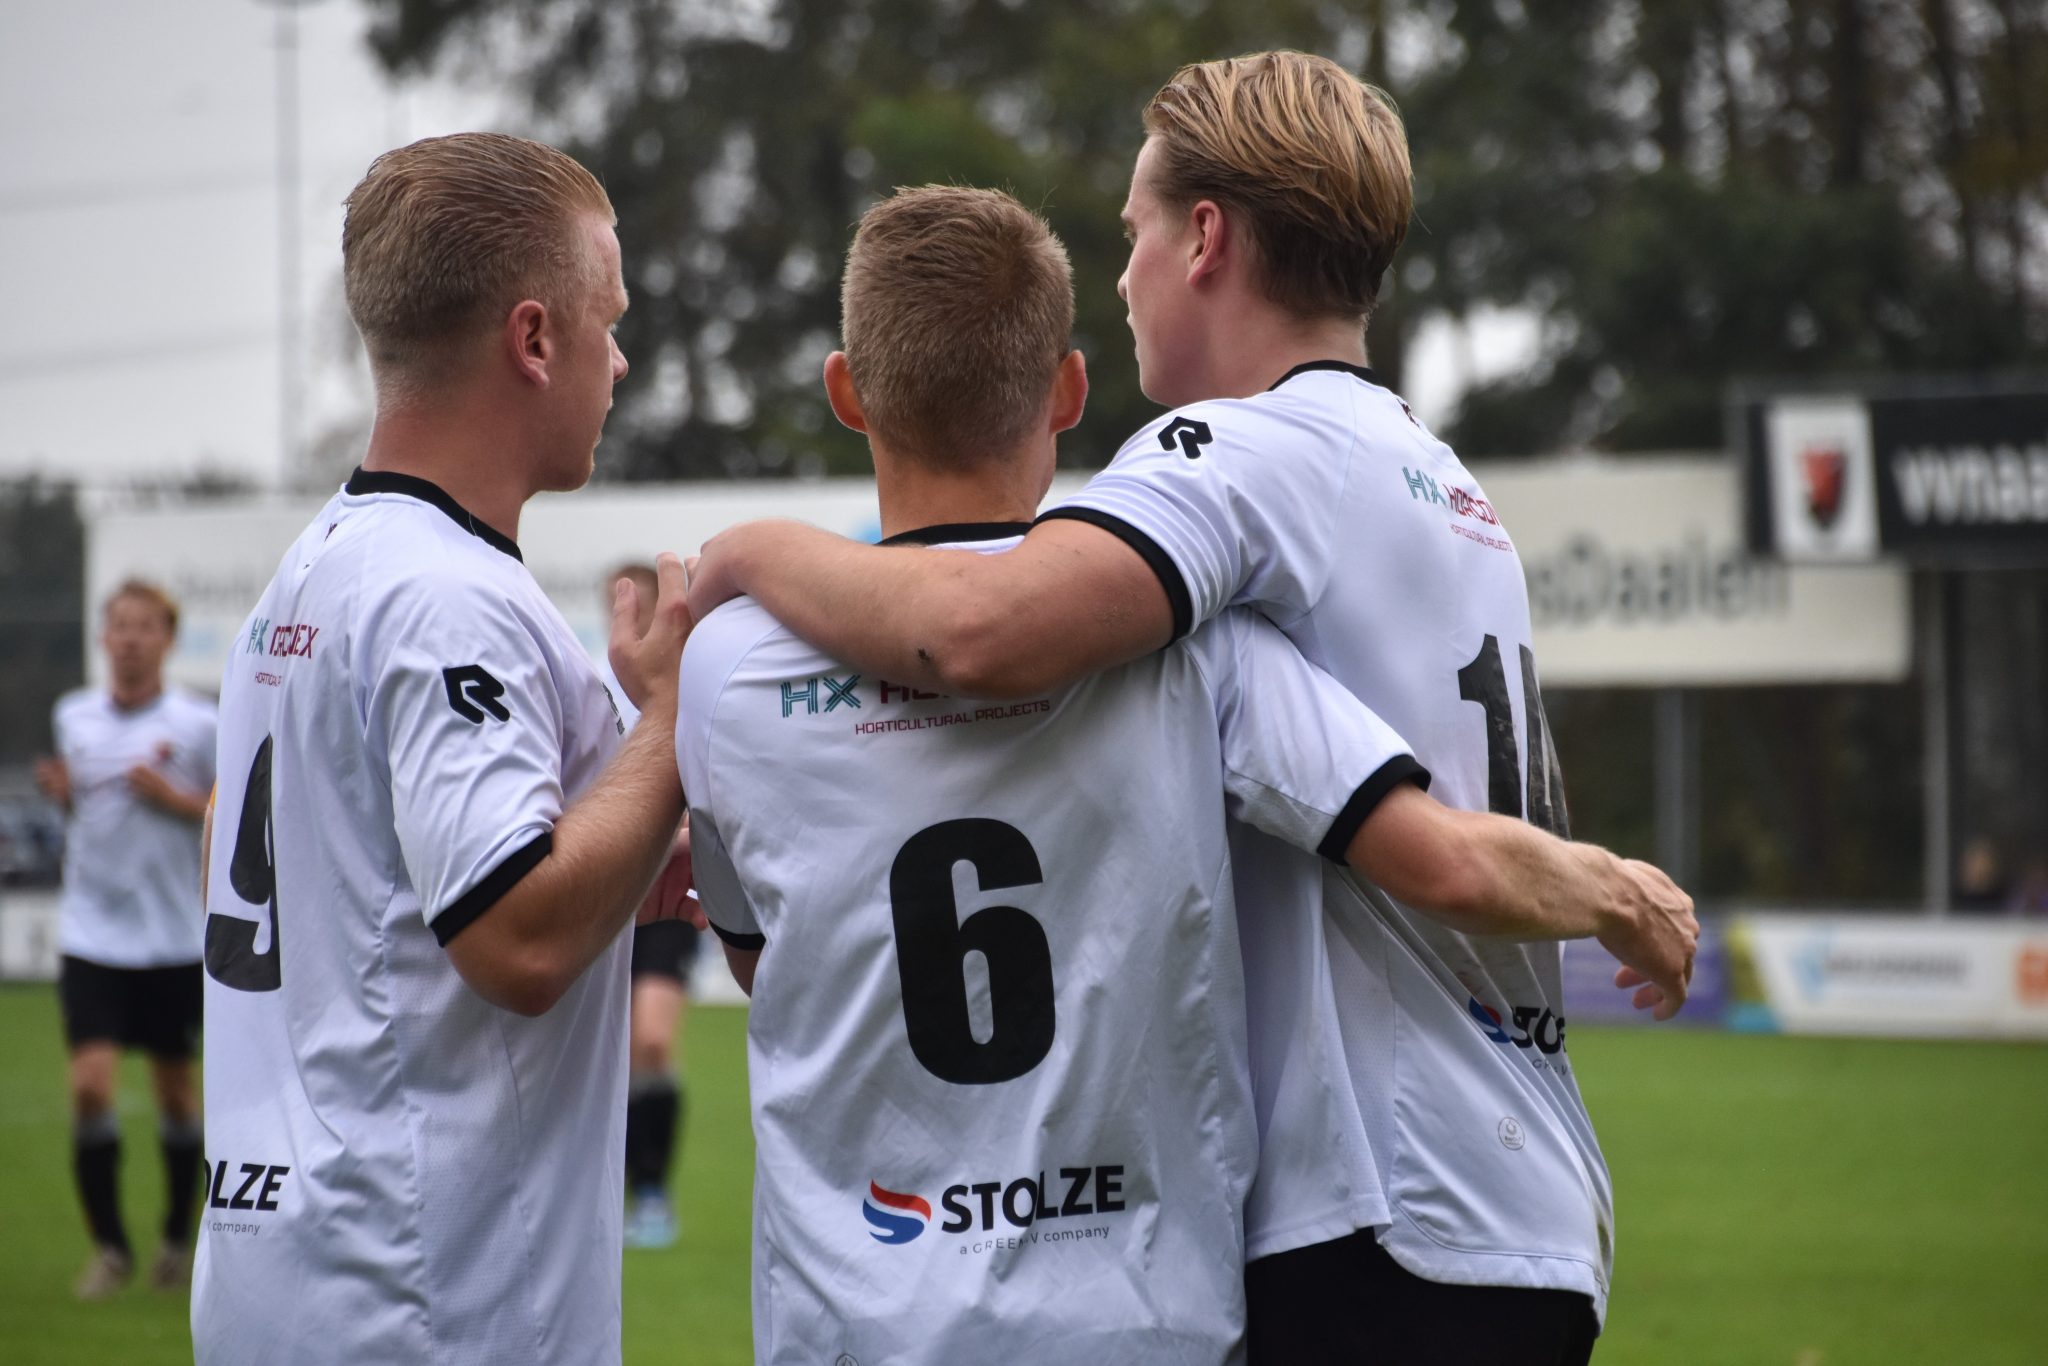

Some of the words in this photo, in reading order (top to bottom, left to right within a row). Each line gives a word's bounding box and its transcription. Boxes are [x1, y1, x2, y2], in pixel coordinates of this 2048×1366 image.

[780, 675, 861, 718] HX
[855, 714, 972, 735] HORTICULTURAL
[975, 700, 1051, 722] PROJECTS
[204, 732, 281, 992] 9
[890, 818, 1056, 1085] 6
[205, 1159, 290, 1211] LZE
[941, 1165, 1126, 1234] STOLZE
[212, 1222, 261, 1236] company
[1043, 1226, 1110, 1243] company
